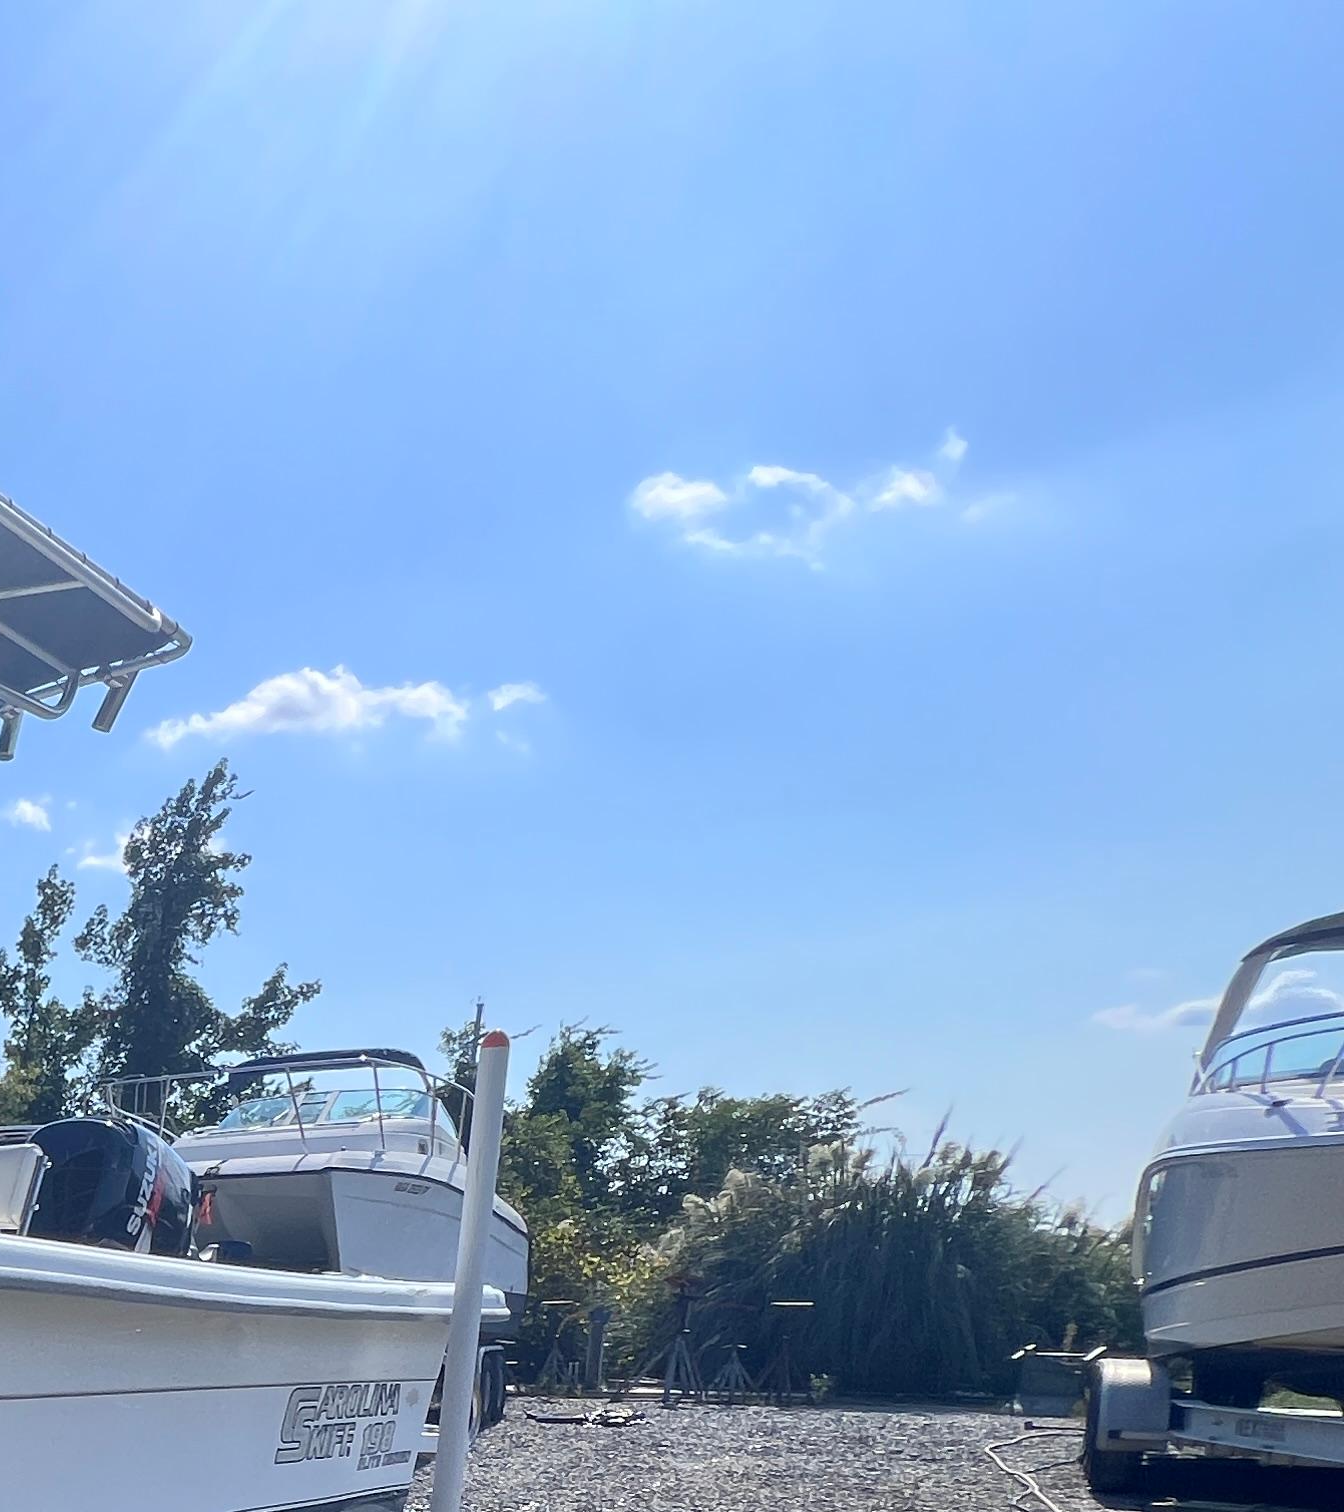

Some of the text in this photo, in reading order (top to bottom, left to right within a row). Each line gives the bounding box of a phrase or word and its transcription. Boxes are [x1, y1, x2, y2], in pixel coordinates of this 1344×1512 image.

[126, 1137, 158, 1236] SUZUKI
[274, 1406, 396, 1464] SKIFF 198
[281, 1383, 401, 1443] CAROLINA
